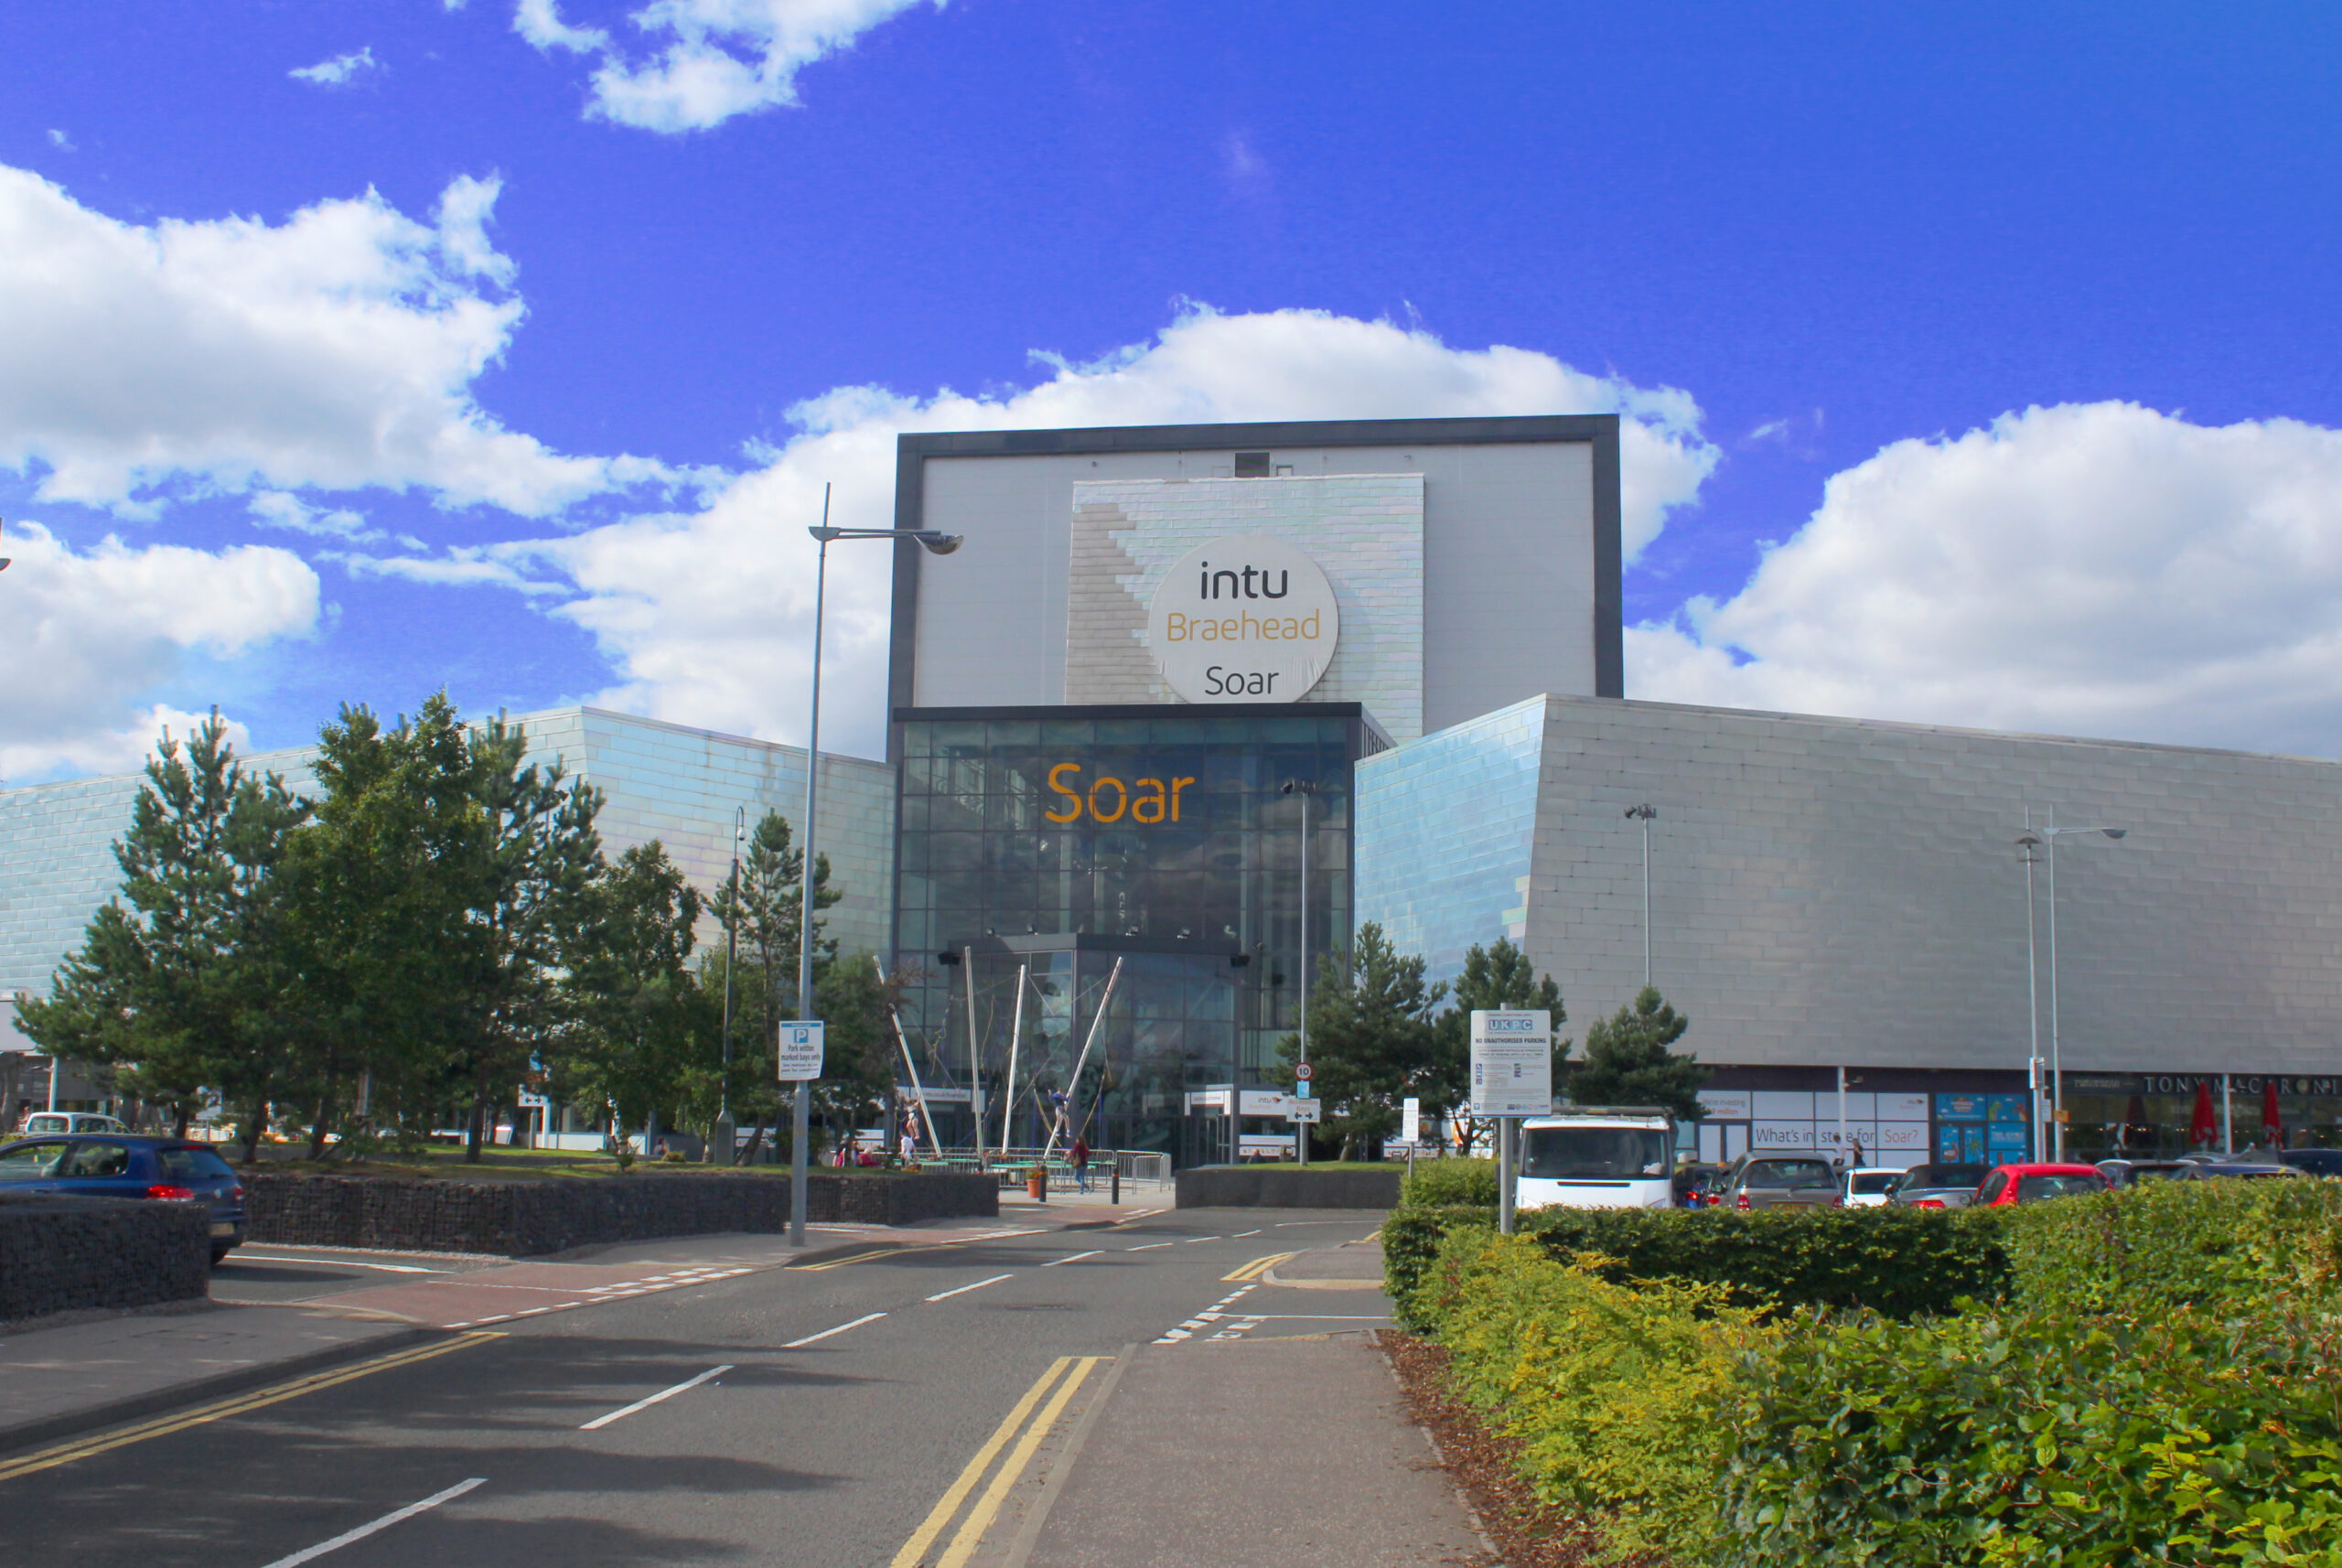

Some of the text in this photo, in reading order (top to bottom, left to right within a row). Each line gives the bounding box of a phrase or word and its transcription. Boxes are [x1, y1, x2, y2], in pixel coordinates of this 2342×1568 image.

[1200, 561, 1288, 599] intu
[1166, 608, 1320, 641] Braehead
[1205, 666, 1279, 695] Soar
[1045, 762, 1195, 823] Soar
[1489, 1019, 1532, 1030] UKPC
[796, 1030, 806, 1042] P
[1299, 1068, 1309, 1076] 10
[2214, 1078, 2337, 1094] MACRNI
[1756, 1127, 1918, 1143] What's in ste for Soar?
